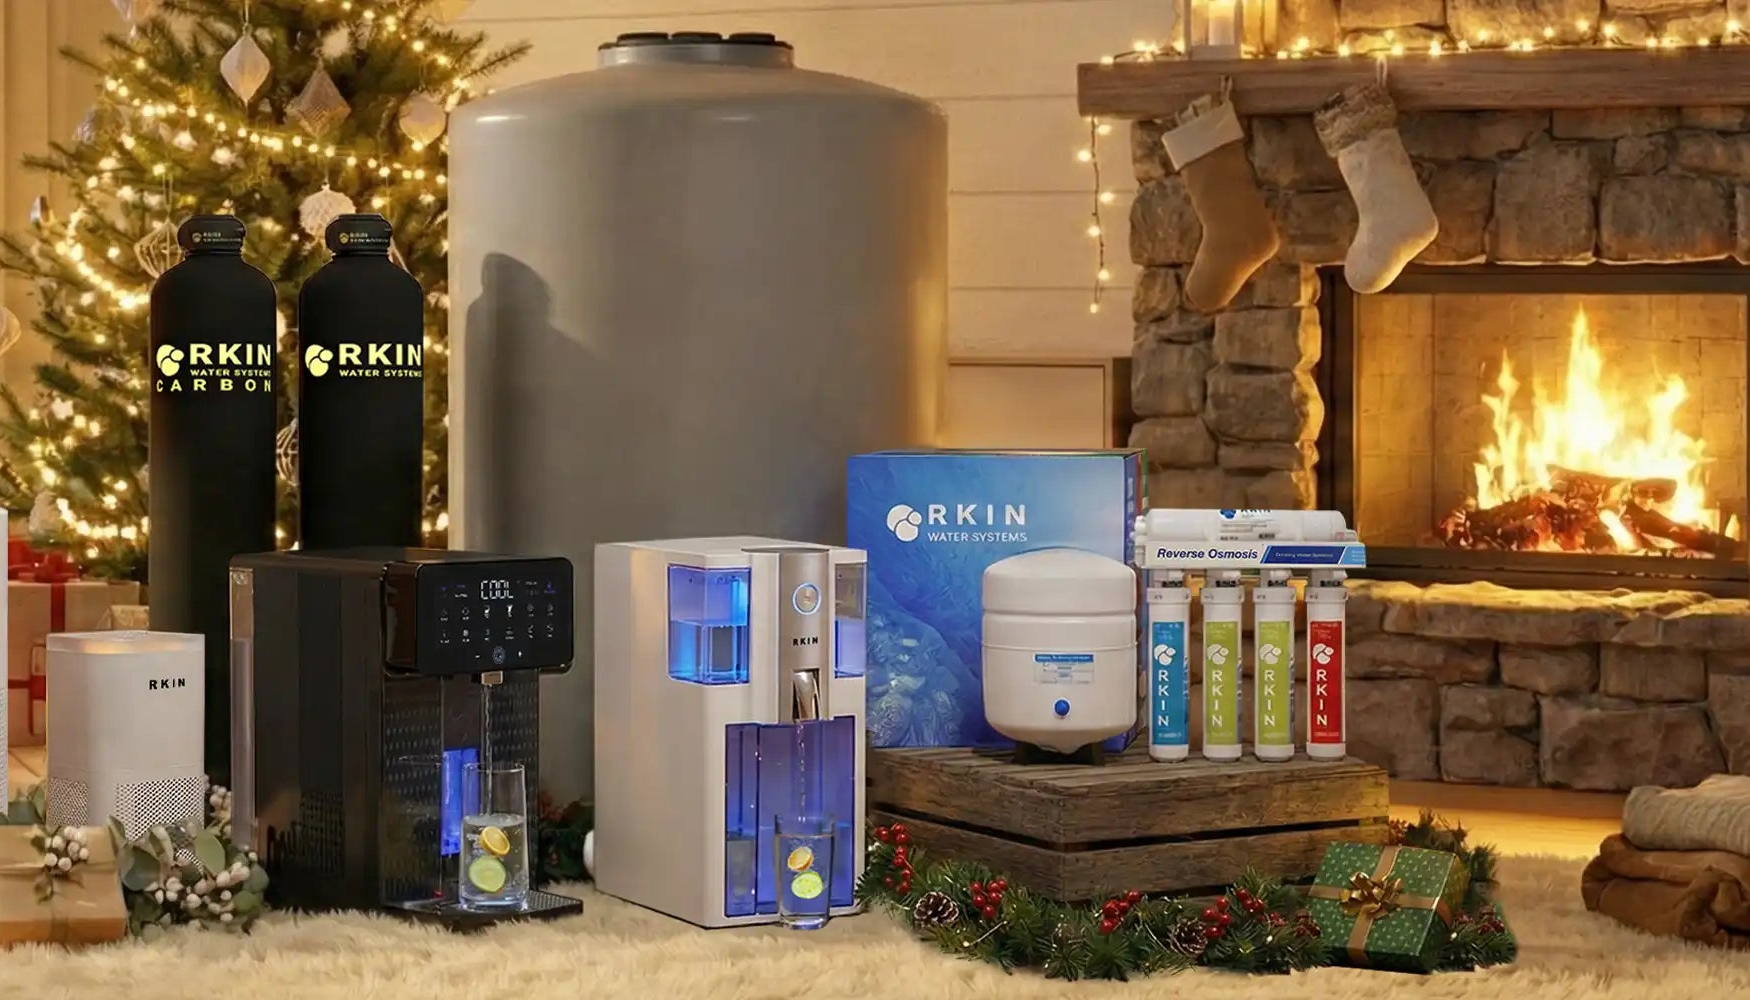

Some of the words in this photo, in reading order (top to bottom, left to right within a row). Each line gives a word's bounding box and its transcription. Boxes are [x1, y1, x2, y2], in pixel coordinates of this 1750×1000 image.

[190, 343, 271, 366] RKIN
[338, 343, 422, 366] RKIN
[190, 368, 230, 377] WATER
[339, 369, 380, 377] WATER
[156, 378, 271, 393] CARBON
[928, 504, 1026, 526] RKIN
[927, 532, 969, 542] WATER
[971, 532, 1028, 542] SYSTEMS
[1157, 548, 1205, 559] Reverse
[1208, 548, 1258, 559] Osmosis
[793, 636, 818, 646] RKIN
[149, 678, 185, 690] RKIN
[1158, 669, 1169, 727] RKIN
[1212, 669, 1223, 727] RKIN
[1264, 669, 1275, 727] RKIN
[1316, 669, 1327, 727] RKIN
